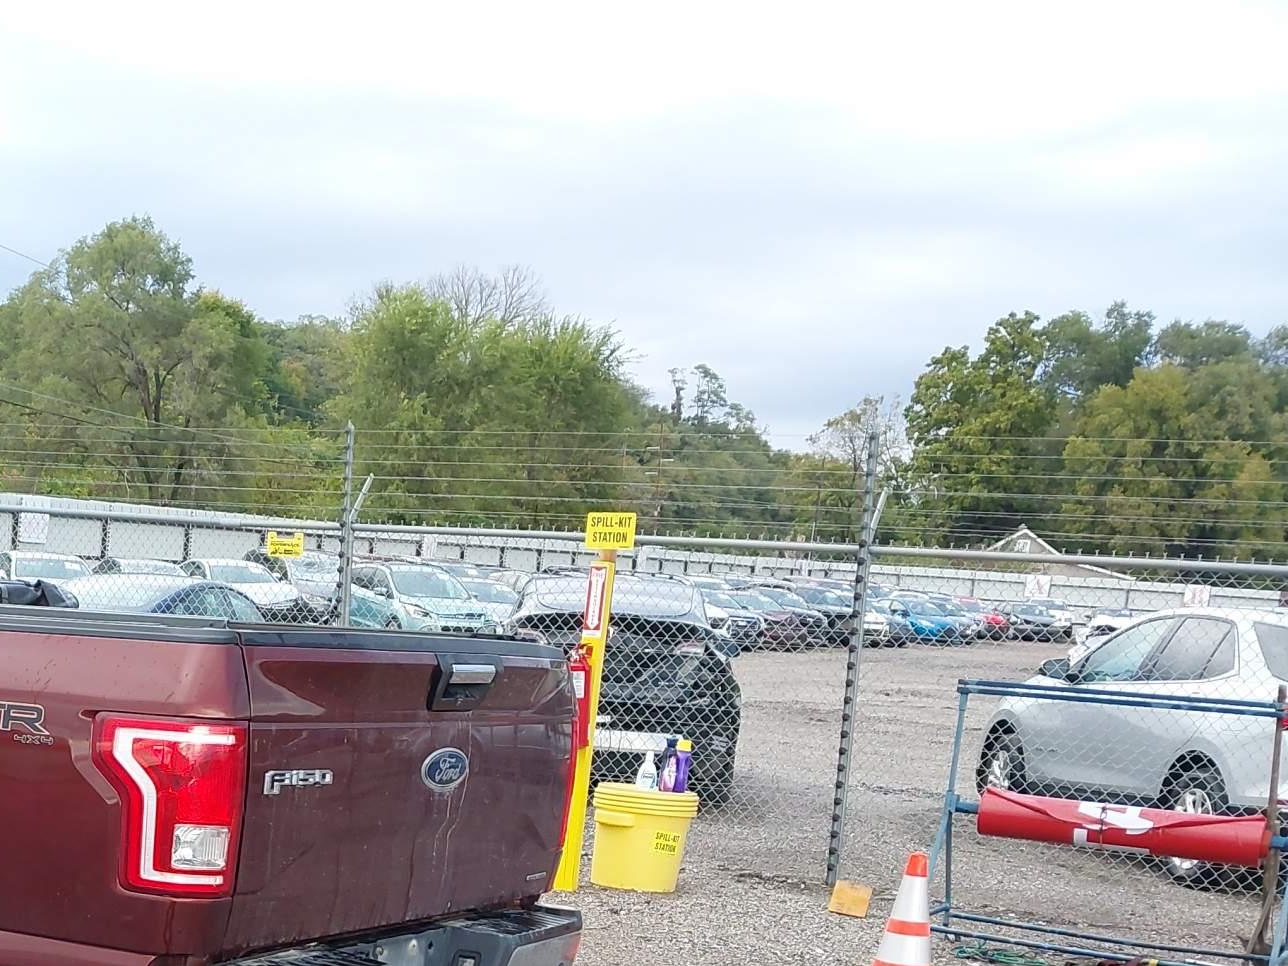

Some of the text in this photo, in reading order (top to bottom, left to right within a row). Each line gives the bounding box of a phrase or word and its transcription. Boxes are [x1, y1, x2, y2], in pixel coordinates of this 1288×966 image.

[590, 516, 633, 529] SPILL-KIT
[592, 531, 628, 543] STATION
[263, 769, 334, 795] F150
[655, 831, 681, 843] SPILL-KIT
[654, 842, 677, 853] STATION
